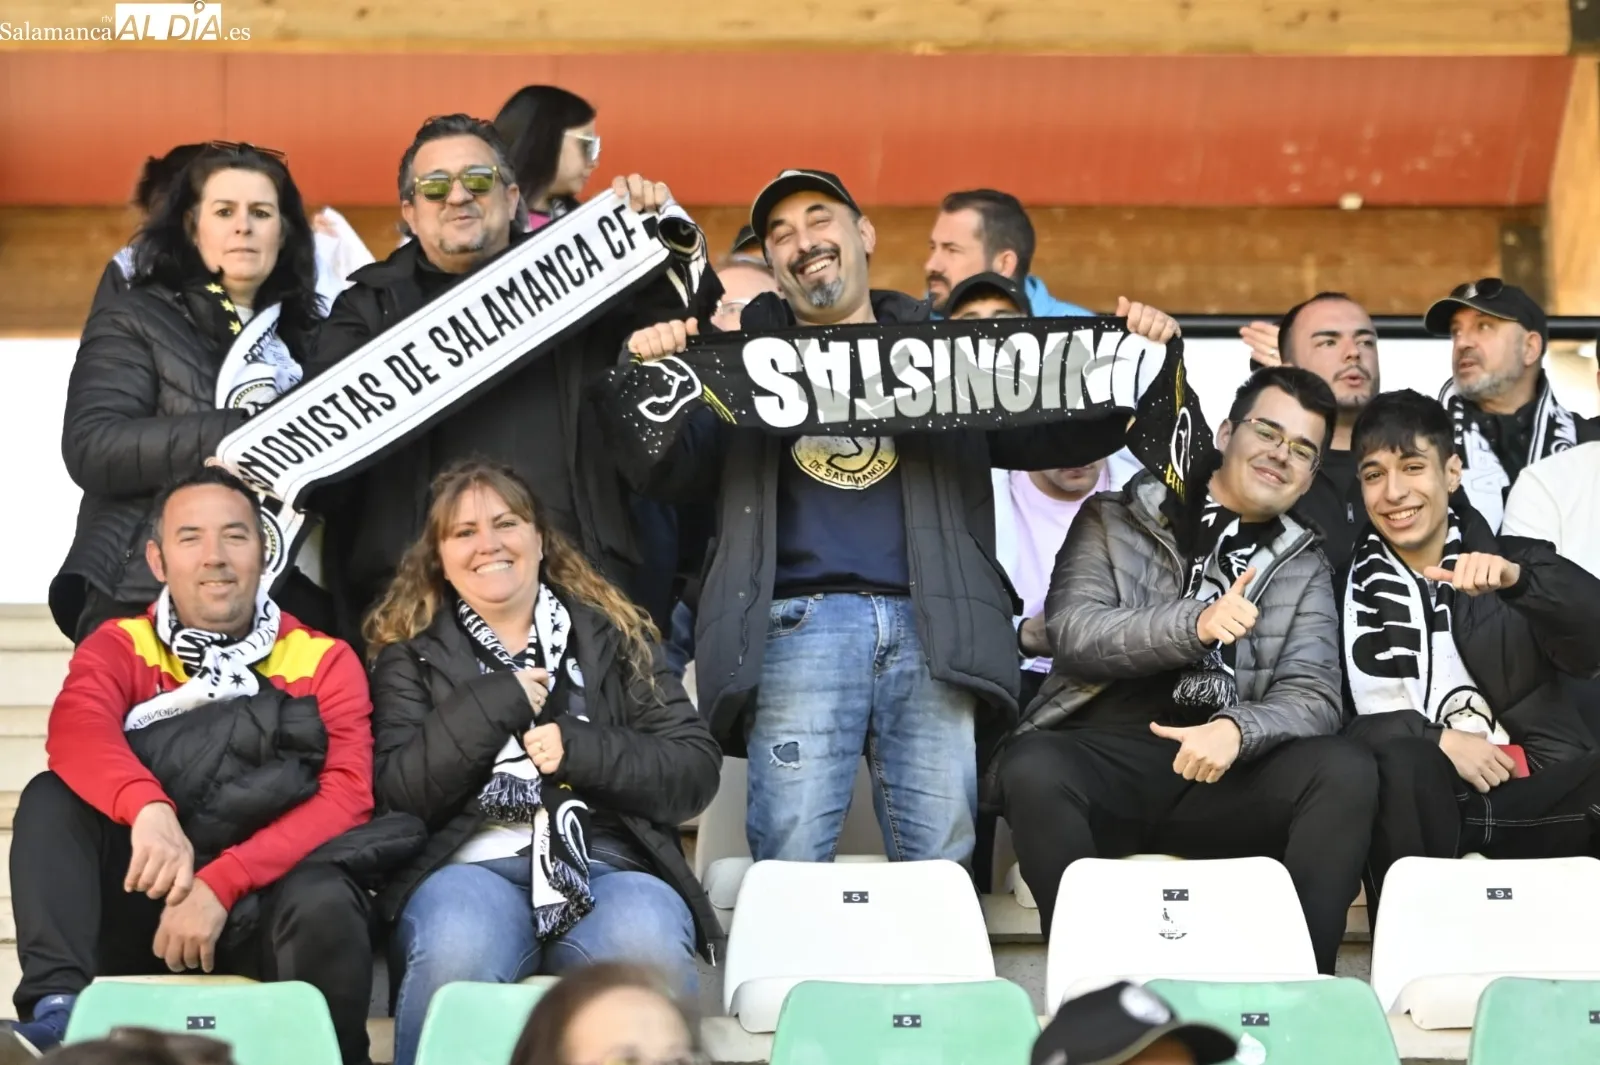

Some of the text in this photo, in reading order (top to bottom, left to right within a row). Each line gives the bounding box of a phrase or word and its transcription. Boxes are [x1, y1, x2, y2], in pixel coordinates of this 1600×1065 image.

[237, 204, 637, 490] NIONISTAS DE SALAMANCA CF
[742, 328, 1167, 429] UNIONISTAS
[808, 459, 888, 485] DE SALAMANCA
